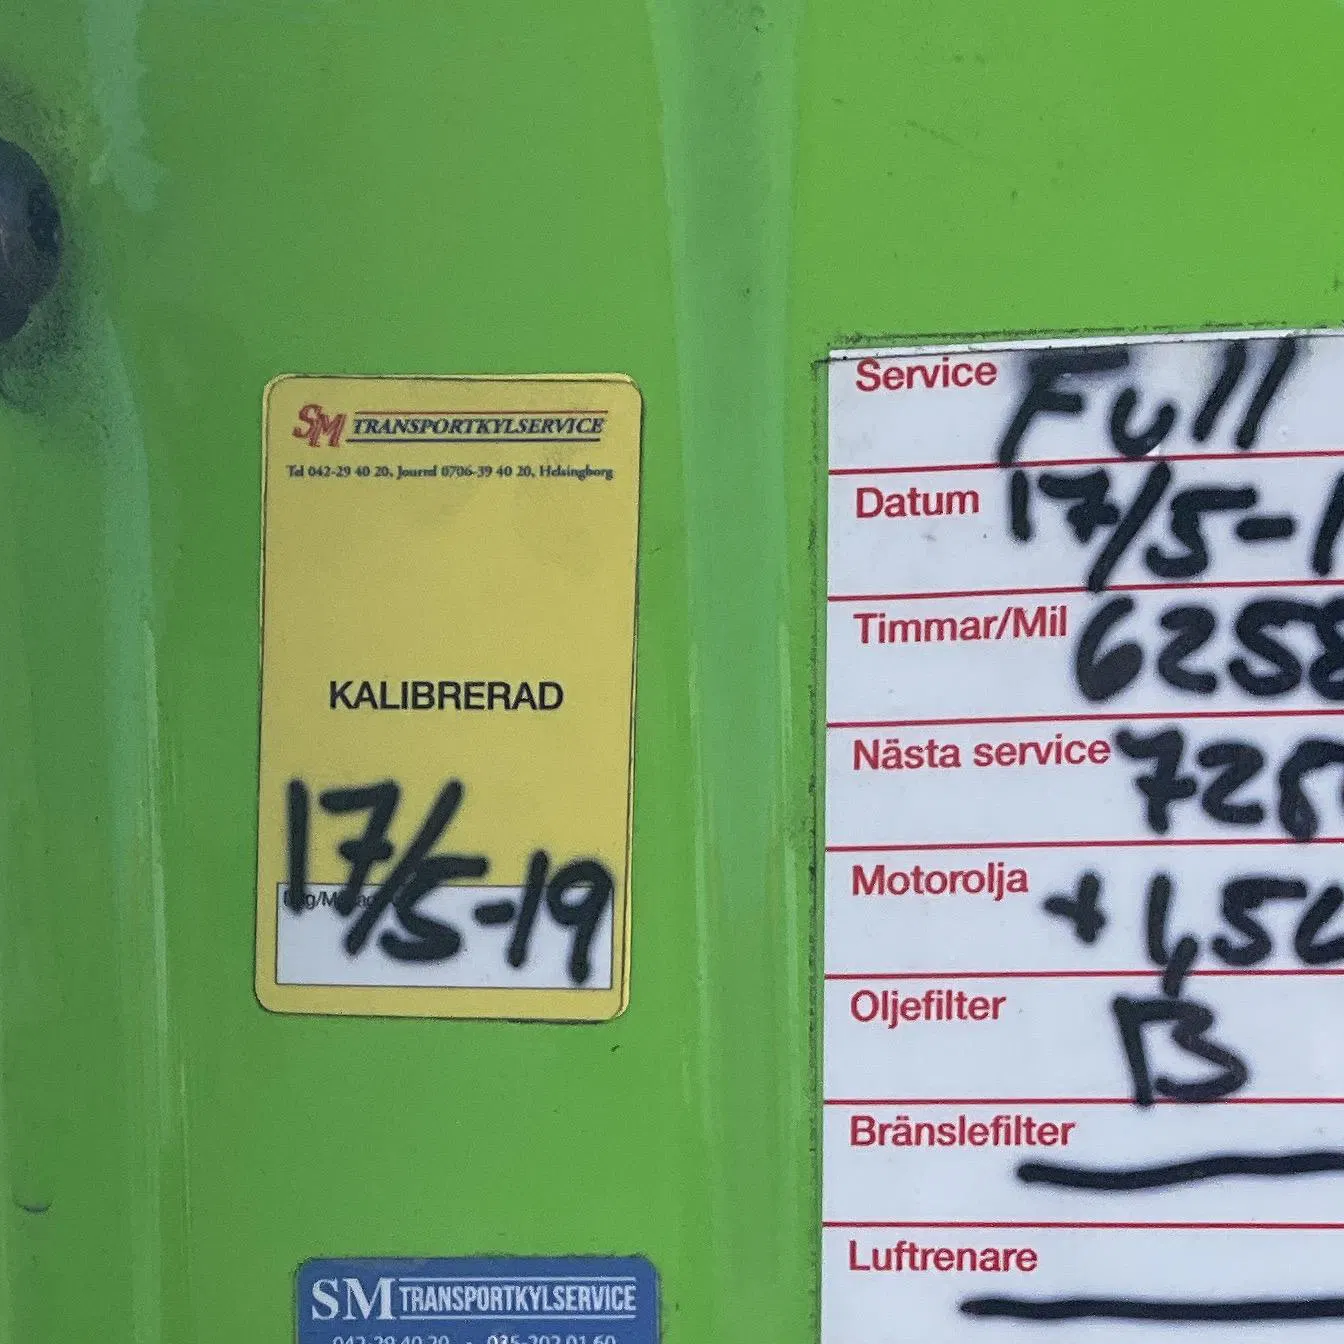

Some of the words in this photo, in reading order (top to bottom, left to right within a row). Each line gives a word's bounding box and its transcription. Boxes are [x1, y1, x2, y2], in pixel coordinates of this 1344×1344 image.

[855, 356, 998, 393] Service
[999, 335, 1299, 467] Full
[293, 404, 346, 447] SM
[353, 417, 604, 434] TRANSPORTKYLSERVICE
[308, 465, 351, 477] 042-29
[496, 465, 512, 477] 40
[539, 464, 613, 481] Helsingborg
[855, 487, 980, 520] Datum
[853, 606, 1068, 644] Timmar/Mil
[329, 680, 564, 710] KALIBRERAD
[852, 738, 961, 771] Nästa
[973, 733, 1111, 767] service
[851, 862, 1029, 897] Motorolja
[850, 989, 1007, 1030] Oljefilter
[849, 1114, 1076, 1148] Bränslefilter
[848, 1240, 1039, 1274] Luftrenare
[311, 1277, 396, 1321] SM
[399, 1285, 636, 1313] TRANSPORTKYLSERVICE
